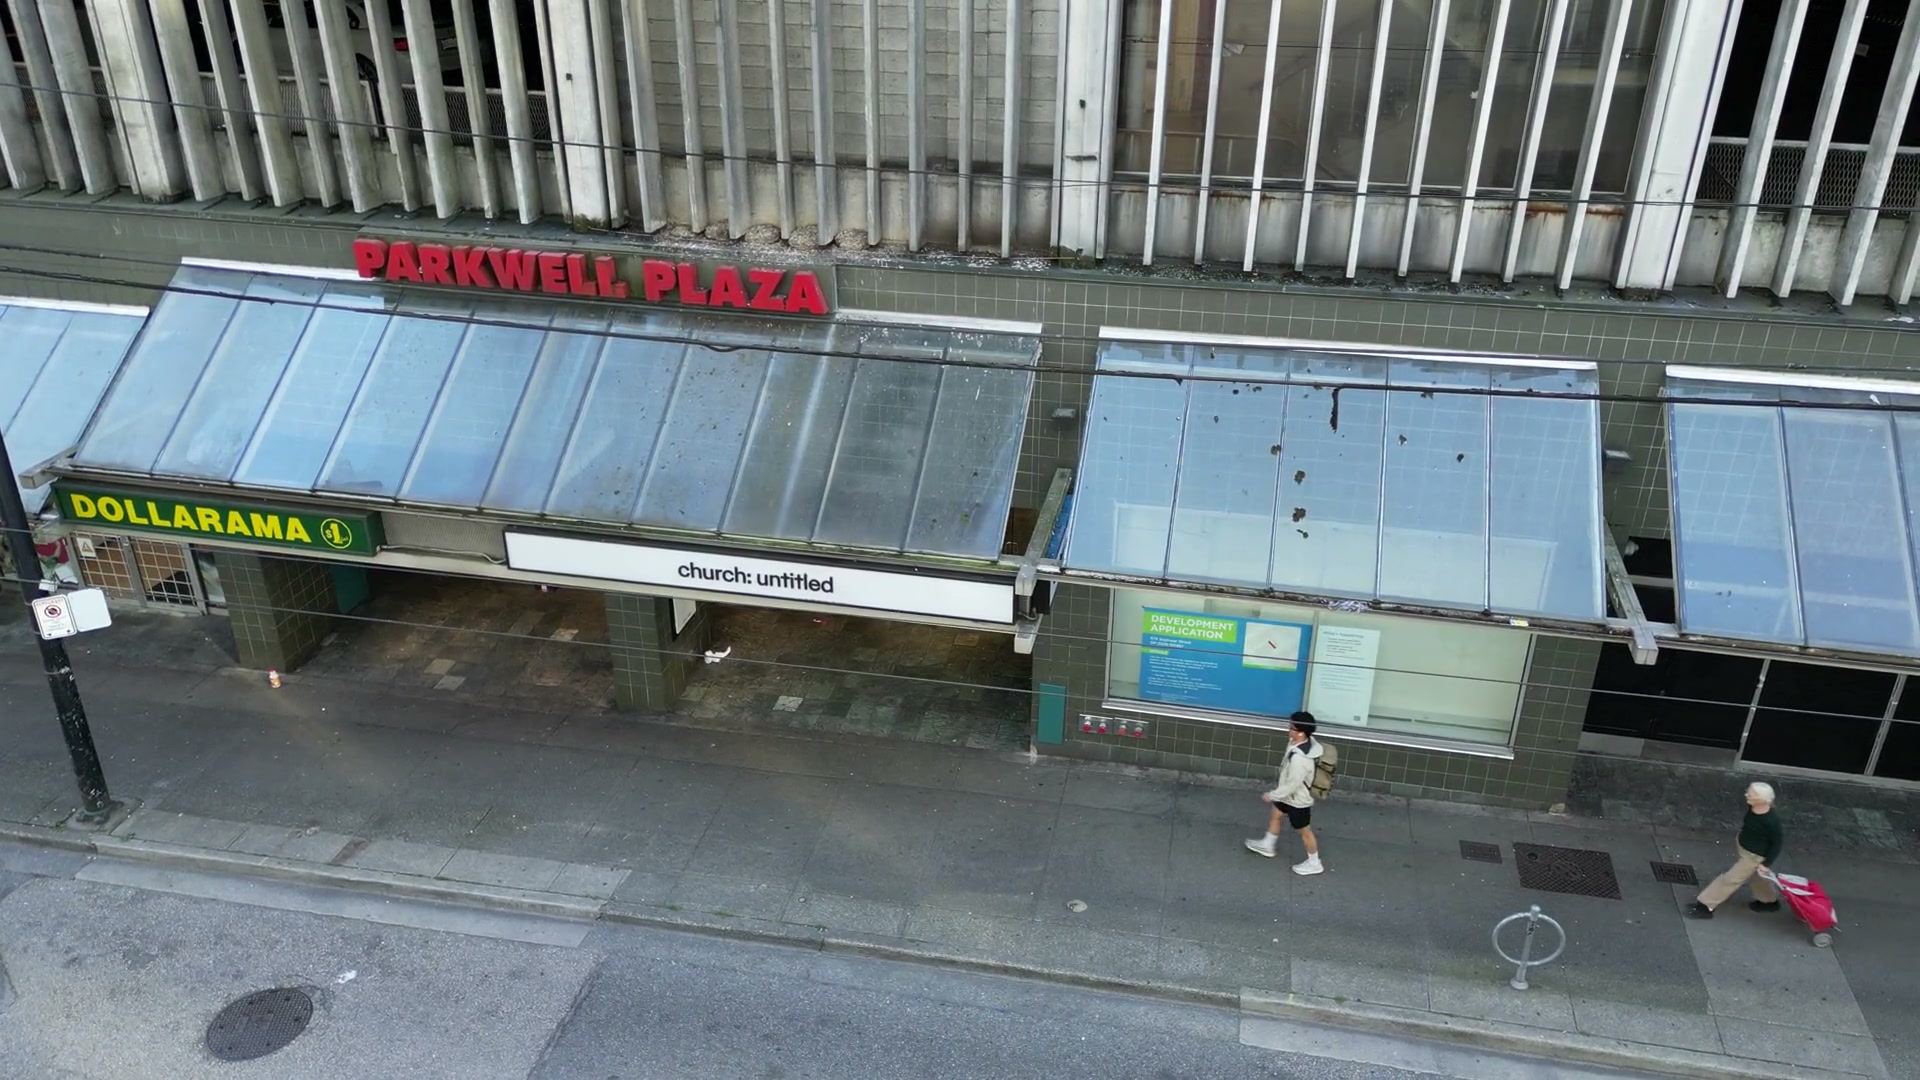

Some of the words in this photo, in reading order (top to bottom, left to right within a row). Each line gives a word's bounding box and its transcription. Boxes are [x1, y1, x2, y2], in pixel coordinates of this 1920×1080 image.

[352, 239, 628, 298] PARKWELL
[643, 259, 827, 314] PLAZA
[70, 494, 311, 543] DOLLARAMA
[678, 562, 752, 584] church:
[757, 572, 834, 593] untitled
[1150, 624, 1224, 639] APPLICATION
[1151, 614, 1234, 631] DEVELOPMENT
